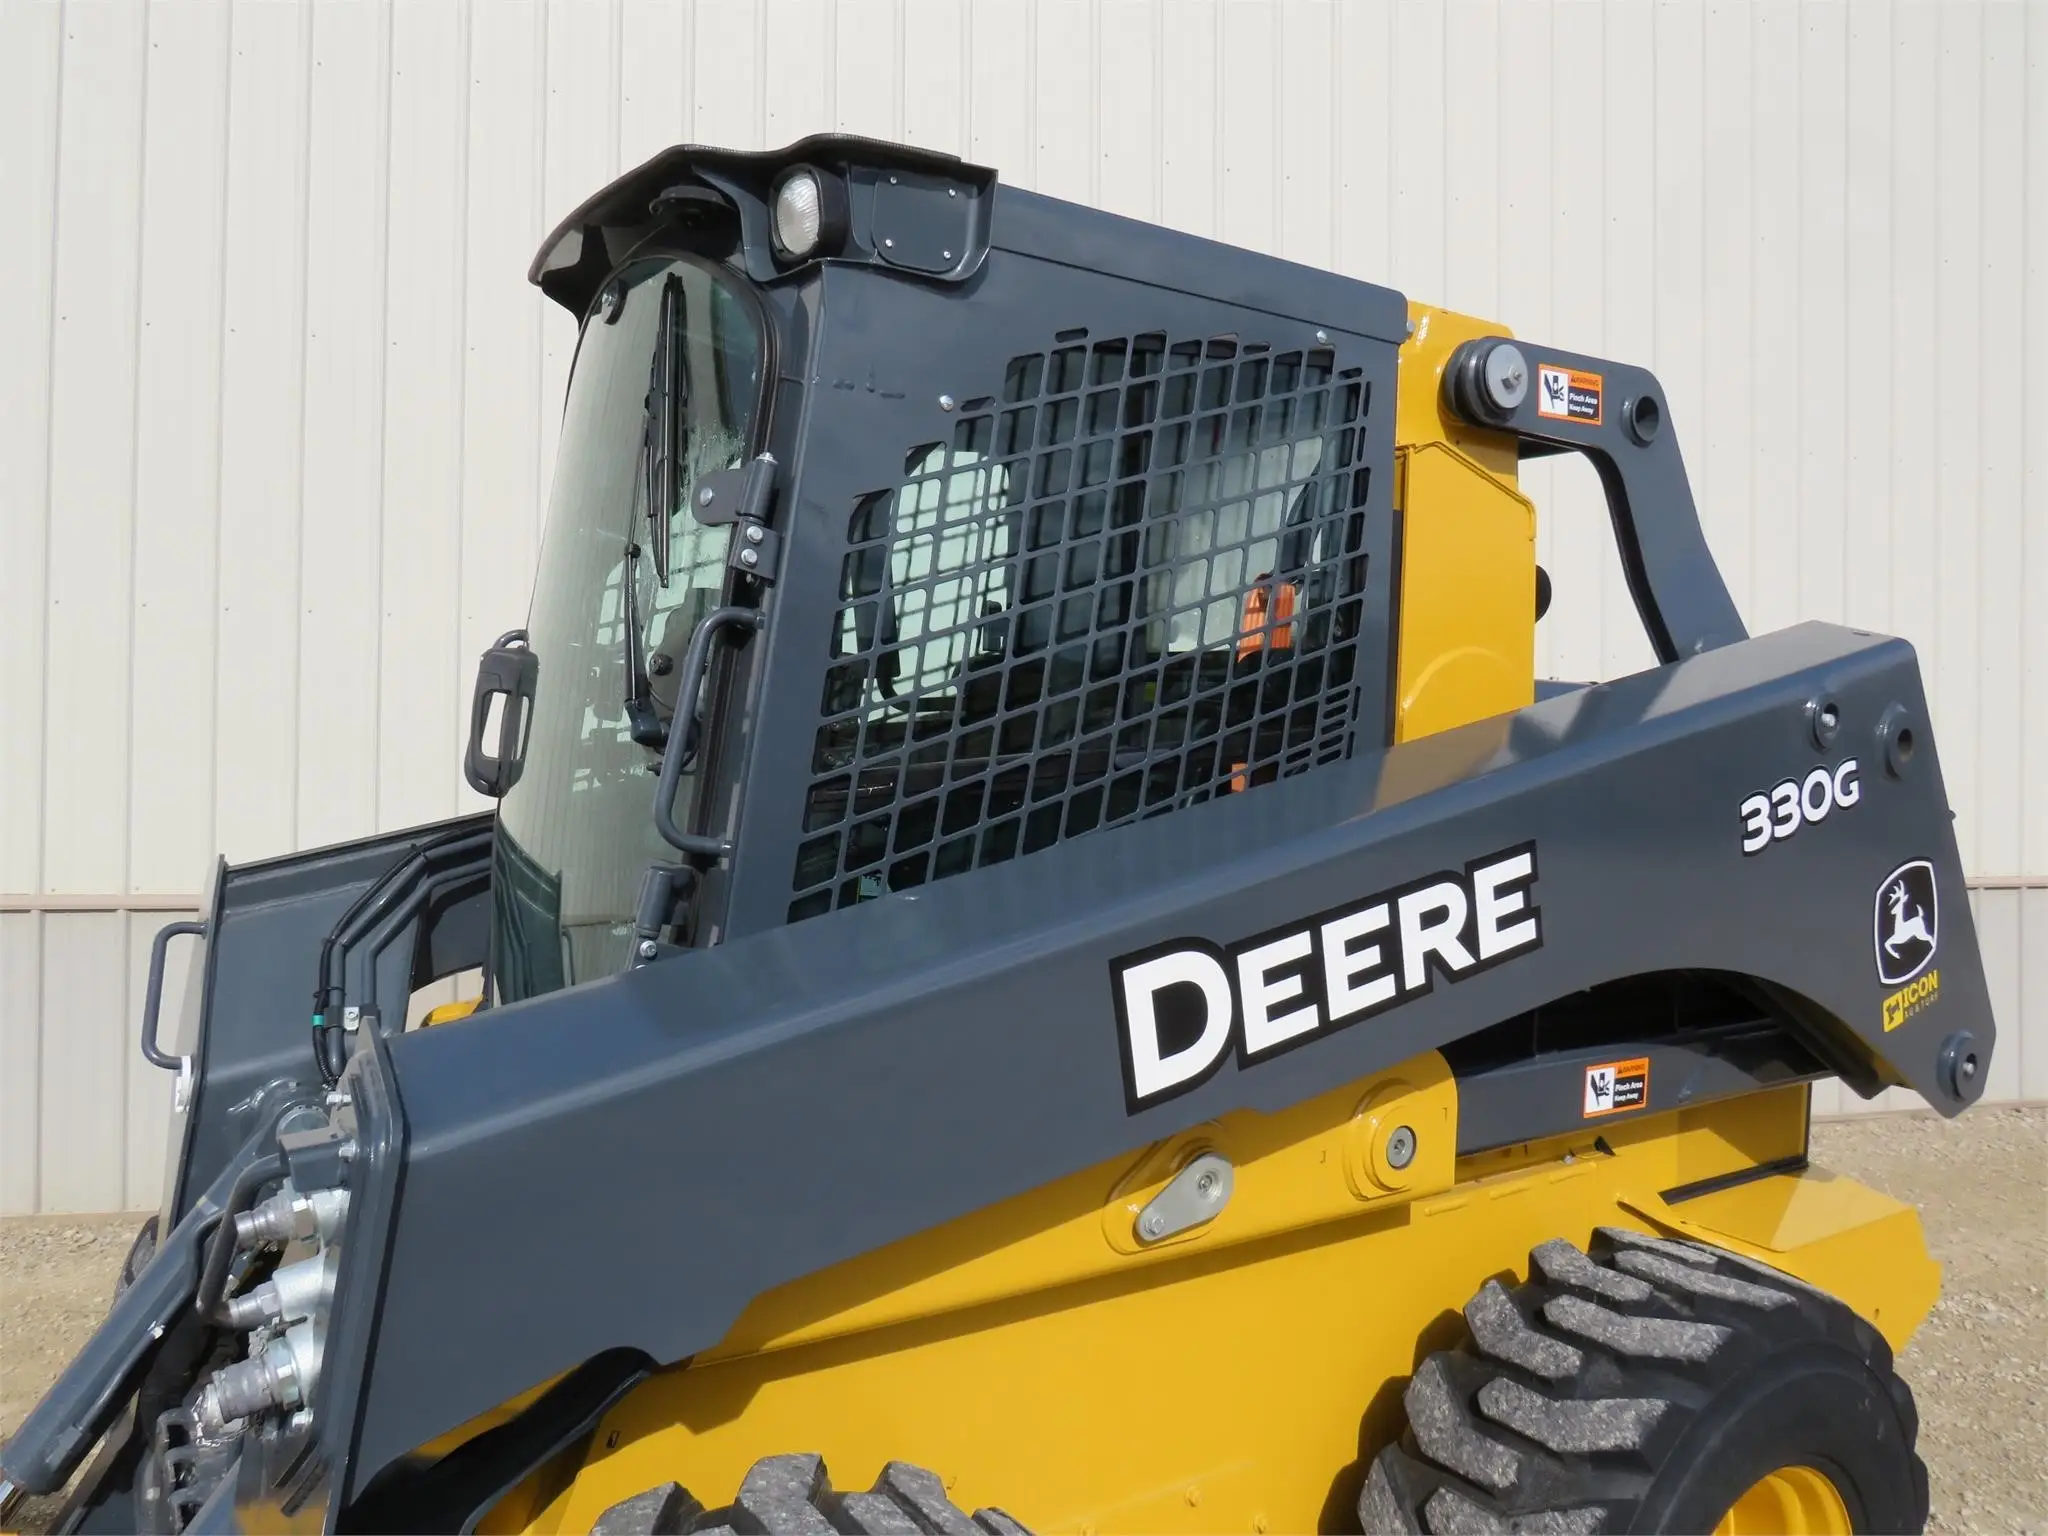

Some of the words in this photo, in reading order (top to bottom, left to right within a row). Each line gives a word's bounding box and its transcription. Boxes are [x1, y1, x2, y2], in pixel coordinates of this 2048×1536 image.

[1569, 392, 1584, 402] Pinch
[1585, 395, 1598, 405] Area
[1569, 403, 1581, 413] Keep
[1581, 406, 1594, 416] Away
[1740, 760, 1861, 853] 330G
[1122, 852, 1538, 1099] DEERE
[1903, 970, 1938, 1007] ICON
[1615, 1083, 1630, 1092] Pinch
[1631, 1081, 1643, 1089] Area
[1614, 1094, 1626, 1102] Keep
[1626, 1092, 1639, 1100] Away
